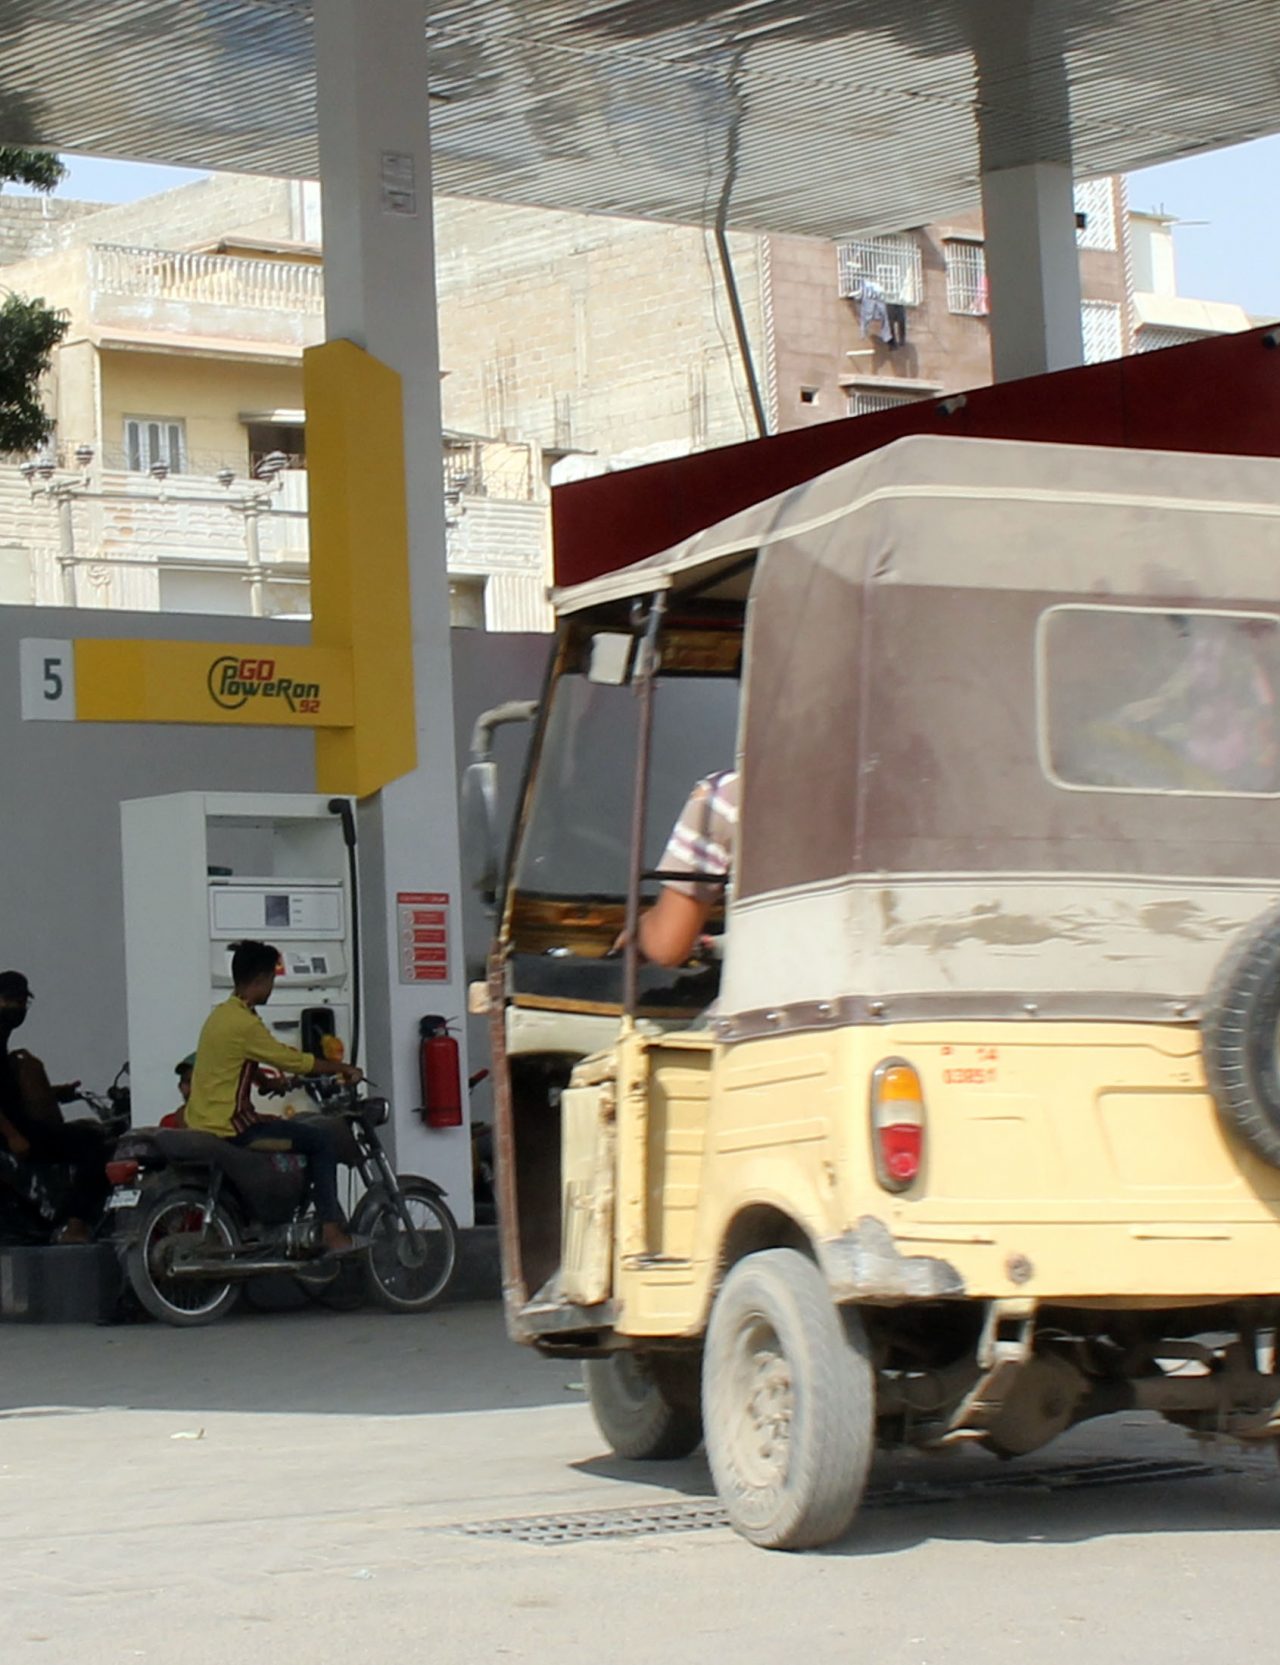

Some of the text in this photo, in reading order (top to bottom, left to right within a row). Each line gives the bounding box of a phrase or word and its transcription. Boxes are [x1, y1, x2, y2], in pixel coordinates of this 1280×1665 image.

[42, 657, 63, 701] 5
[239, 658, 276, 681] GO
[299, 699, 321, 714] 92
